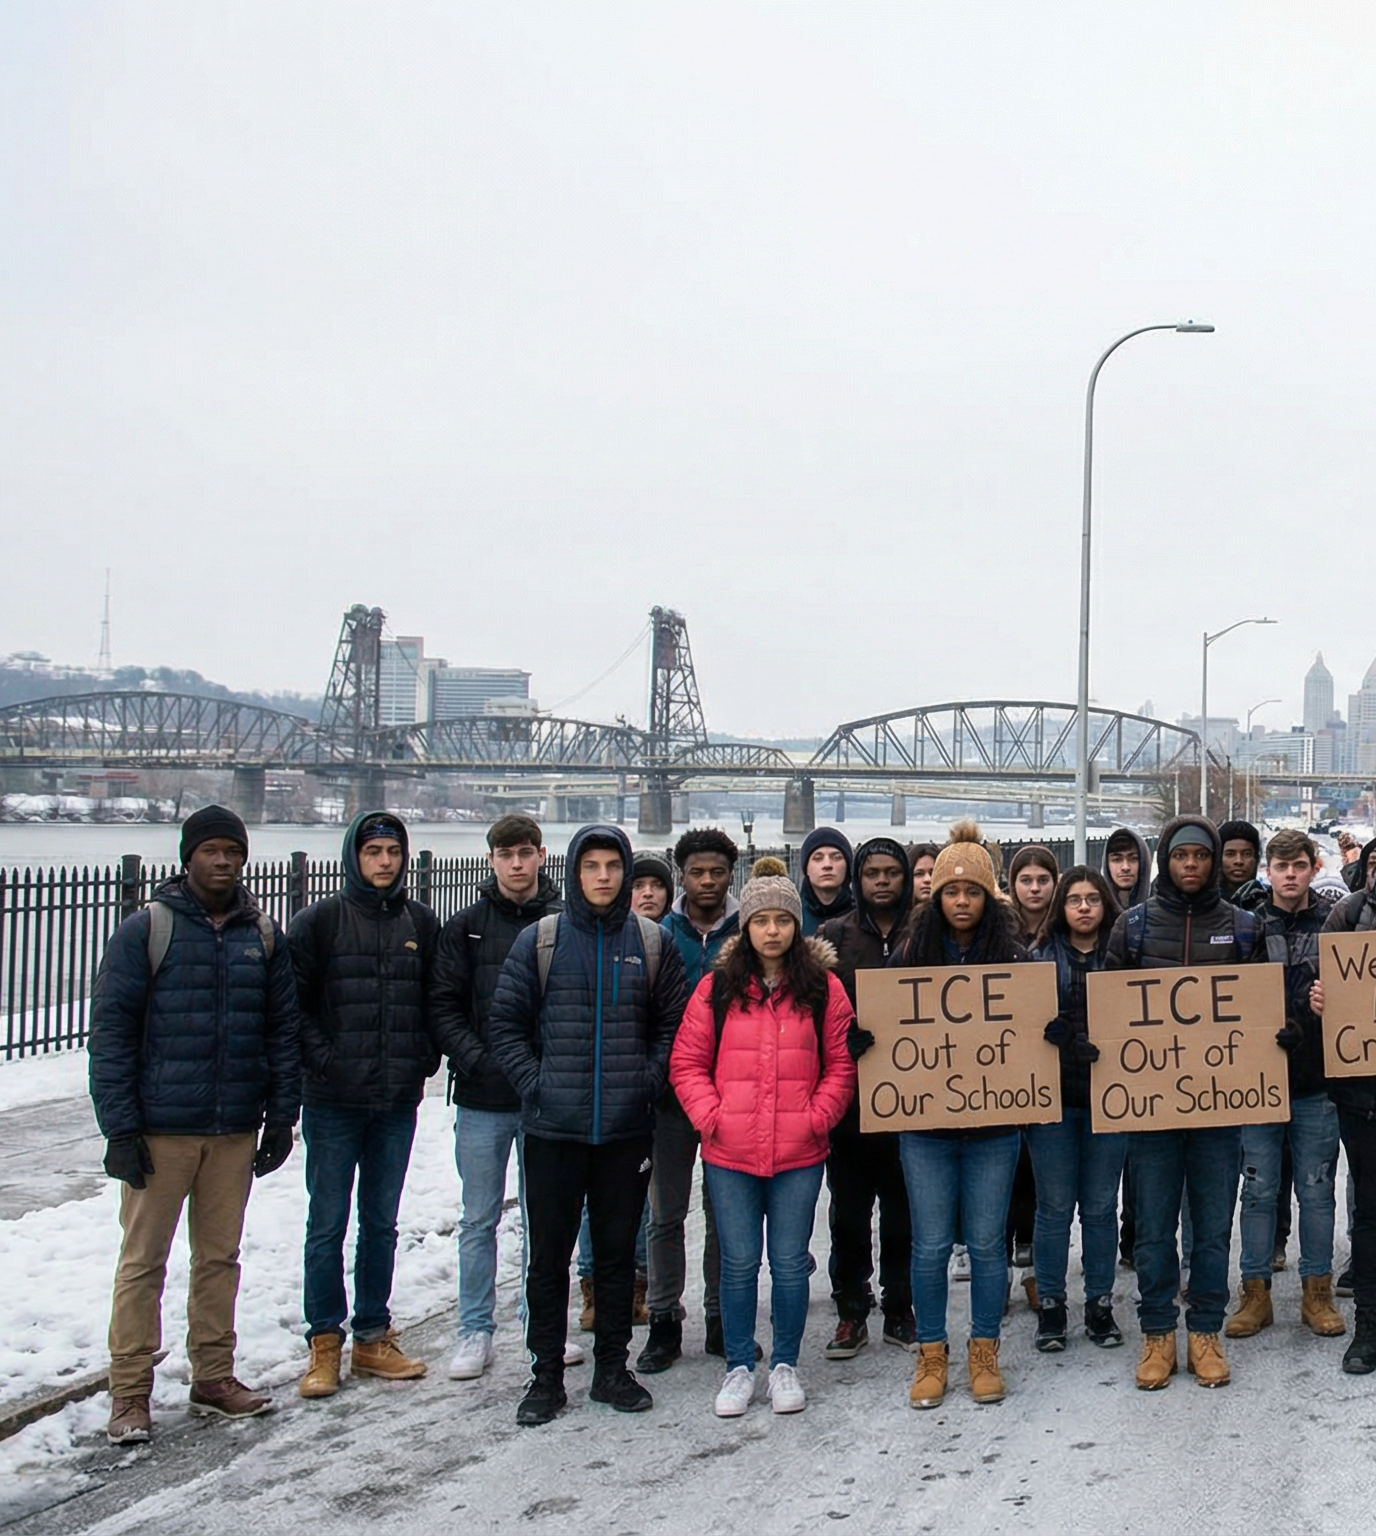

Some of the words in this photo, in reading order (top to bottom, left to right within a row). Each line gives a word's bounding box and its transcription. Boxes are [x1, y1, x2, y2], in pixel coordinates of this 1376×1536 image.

[898, 973, 1013, 1024] ICE
[1127, 975, 1241, 1026] ICE
[892, 1033, 956, 1071] Out
[976, 1029, 1016, 1066] of
[1120, 1035, 1186, 1073] Out
[1205, 1030, 1244, 1067] of
[871, 1082, 934, 1118] Our
[946, 1073, 1052, 1113] Schools
[1102, 1083, 1163, 1119] Our
[1176, 1072, 1281, 1113] Schools
